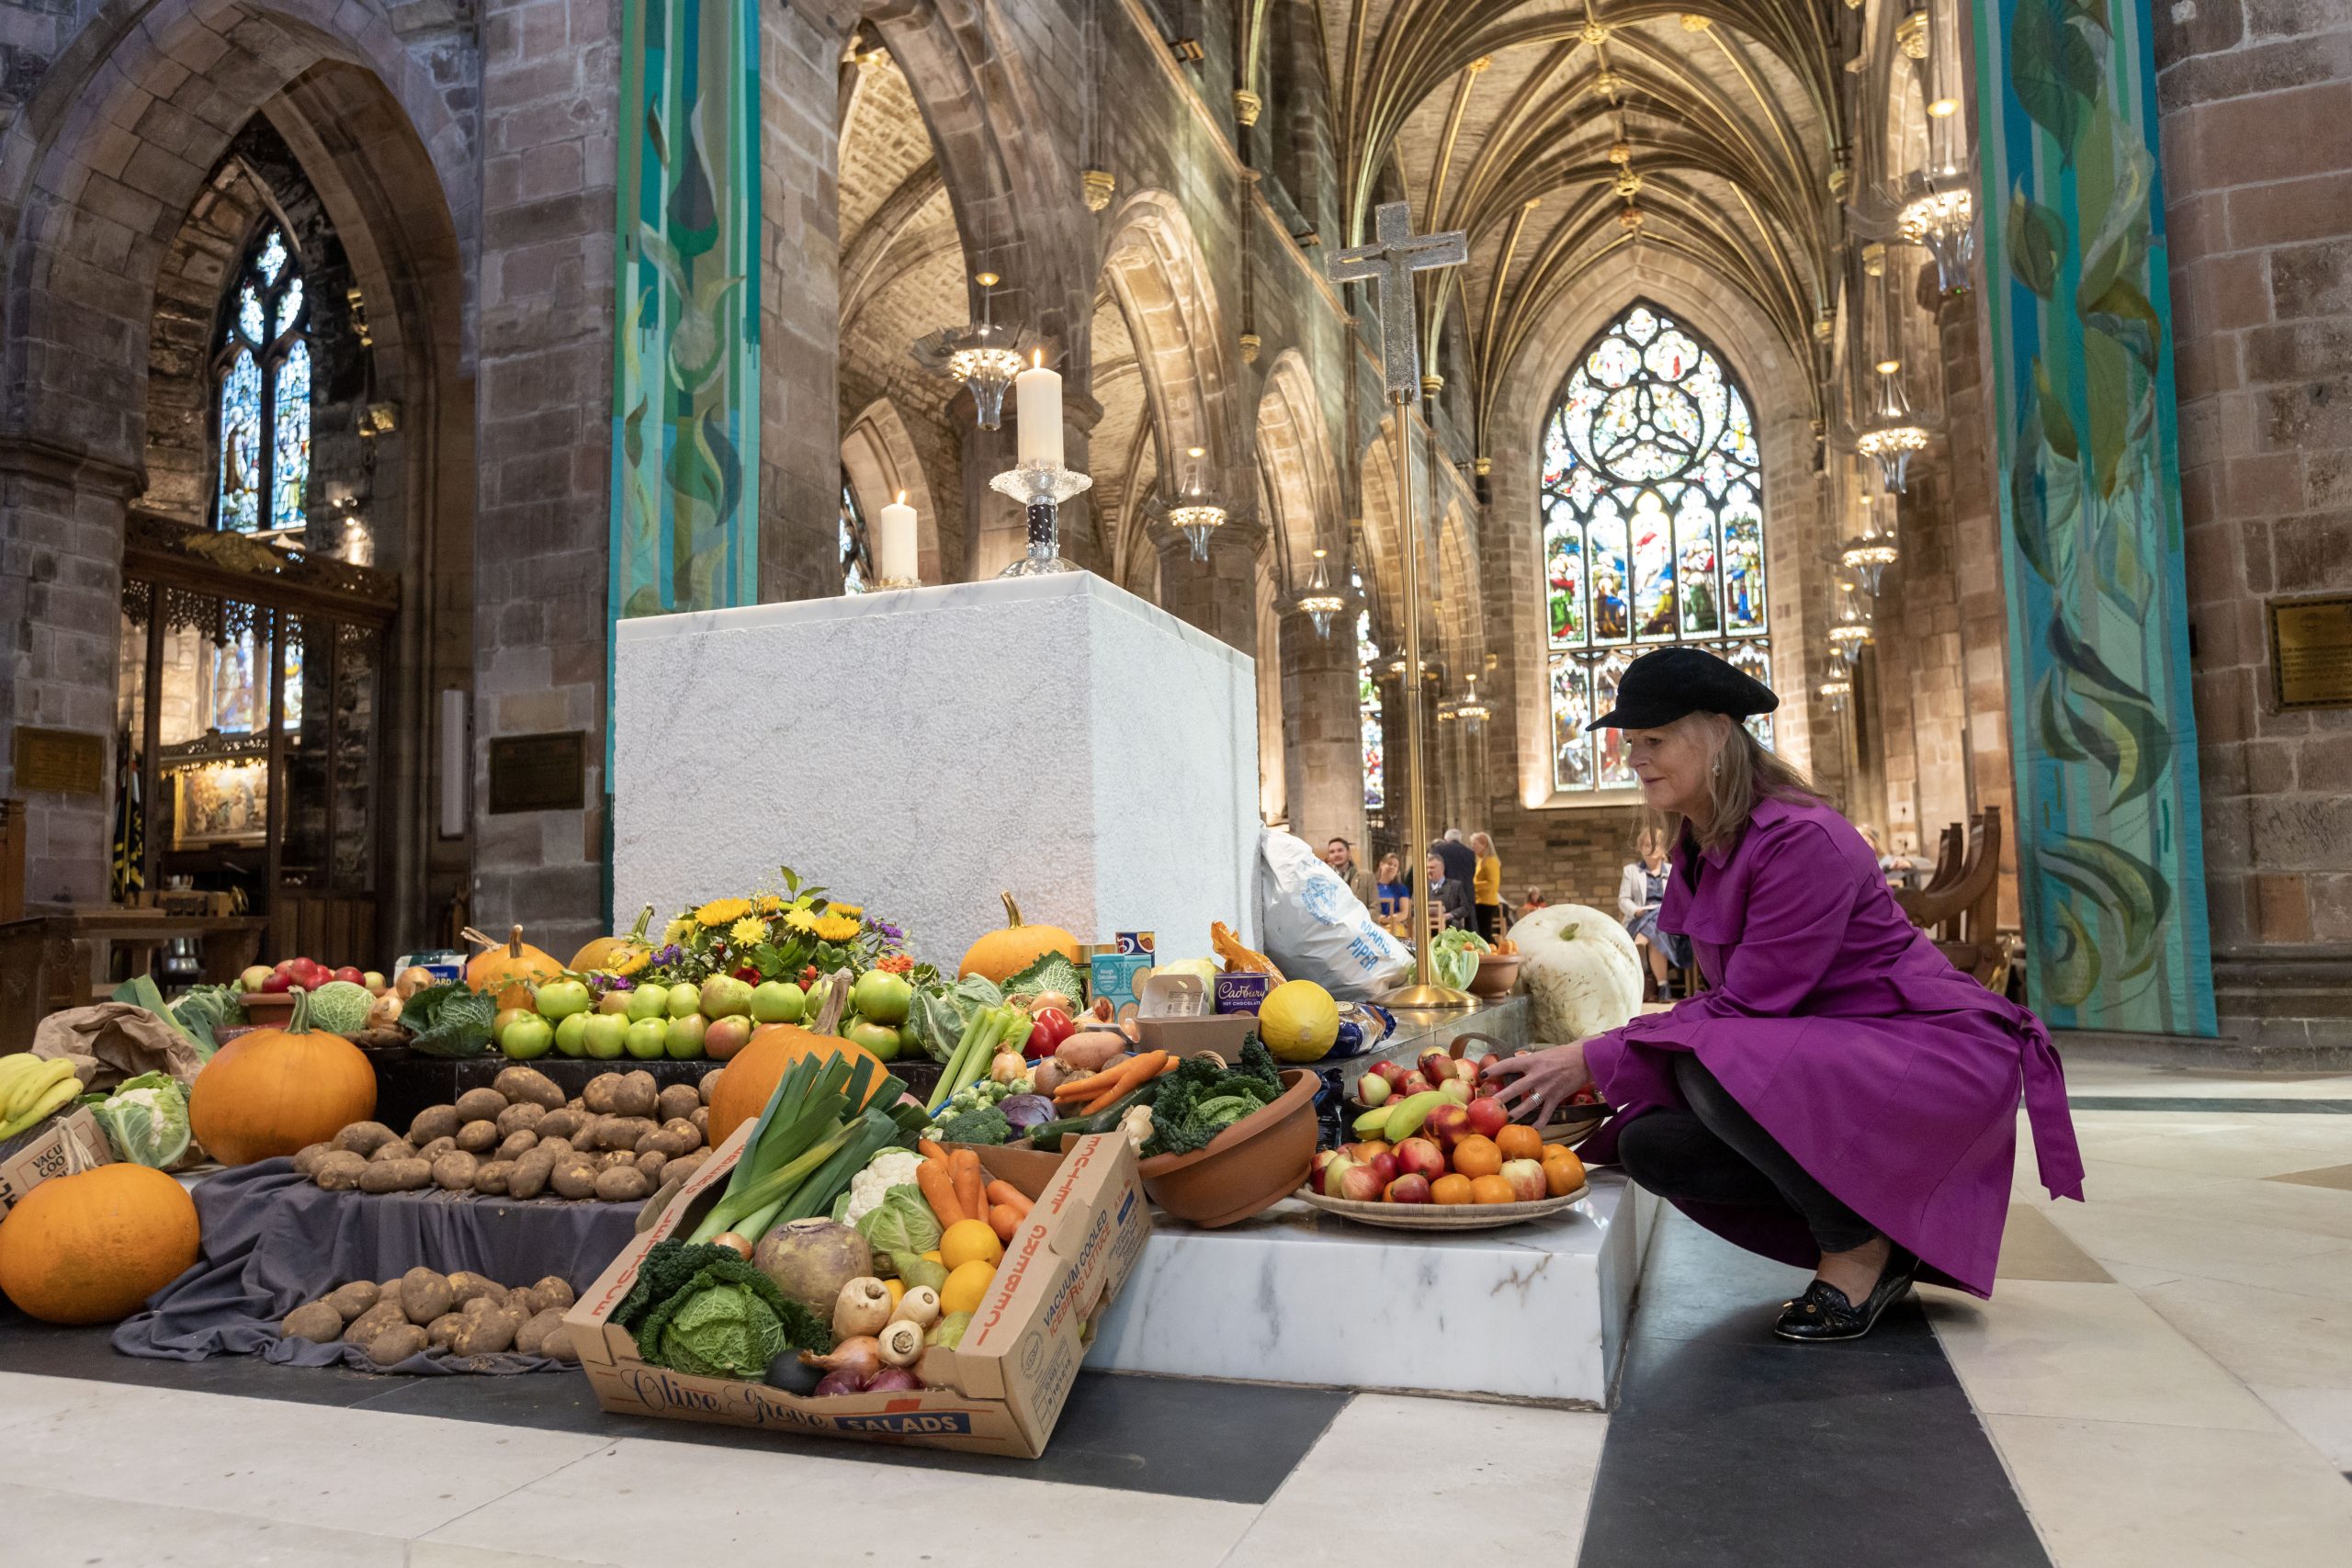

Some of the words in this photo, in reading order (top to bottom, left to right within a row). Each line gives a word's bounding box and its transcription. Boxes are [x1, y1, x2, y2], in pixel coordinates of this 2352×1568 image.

[1347, 936, 1379, 971] PIPER
[1218, 981, 1265, 1001] Cadbury
[32, 1144, 62, 1168] VACU
[40, 1156, 65, 1177] COO
[592, 1209, 674, 1315] LETTUCE
[977, 1224, 1047, 1346] ICEBERG
[1051, 1136, 1102, 1214] LETTUCE
[1044, 1263, 1080, 1327] VACUUM
[1080, 1210, 1107, 1267] COOLED
[1049, 1277, 1084, 1337] ICEBERG
[1084, 1224, 1111, 1280] LETTUCE
[620, 1369, 721, 1412] Olive
[723, 1385, 826, 1428] Grove
[846, 1416, 958, 1434] SALADS
